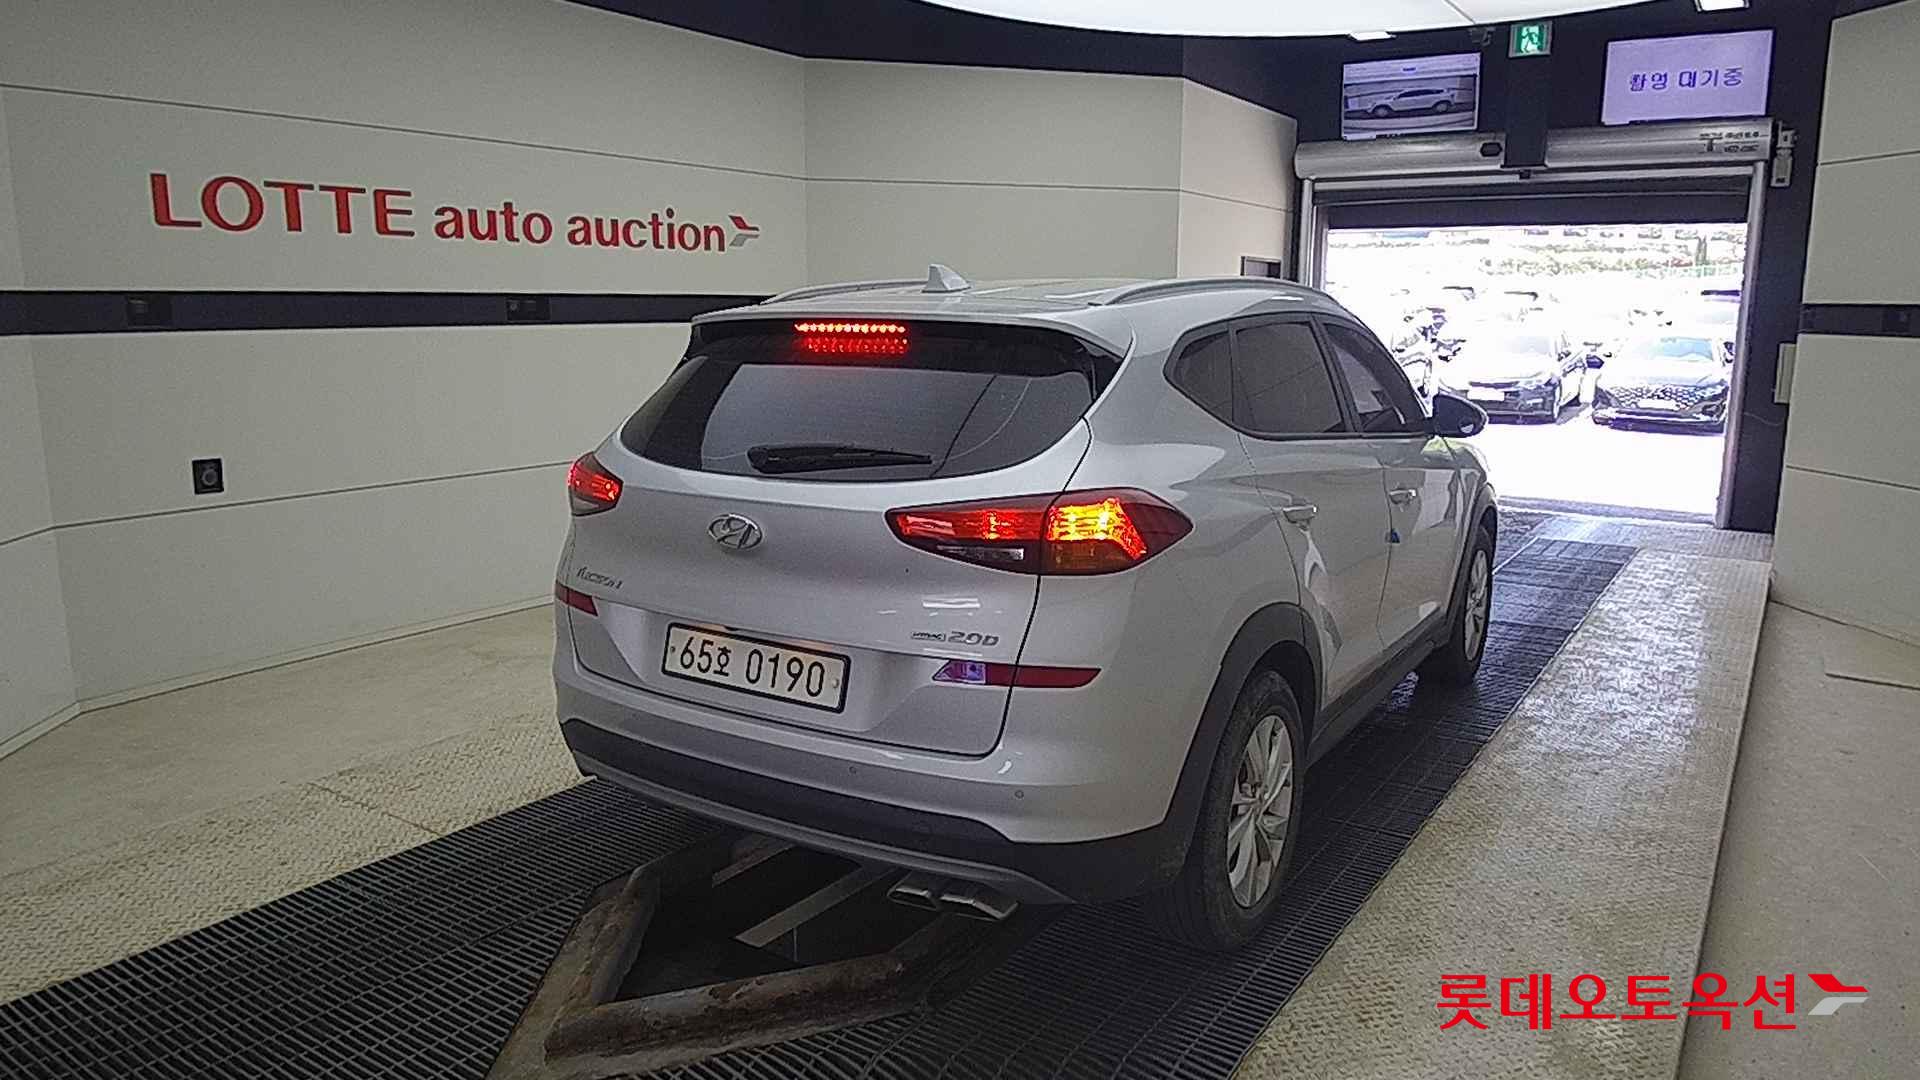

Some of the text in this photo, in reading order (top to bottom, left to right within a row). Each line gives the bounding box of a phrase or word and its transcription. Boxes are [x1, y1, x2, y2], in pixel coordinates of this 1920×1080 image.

[1678, 67, 1743, 88] 대기중
[150, 173, 726, 251] LOTTE auto auction
[680, 637, 825, 697] 65호 0190
